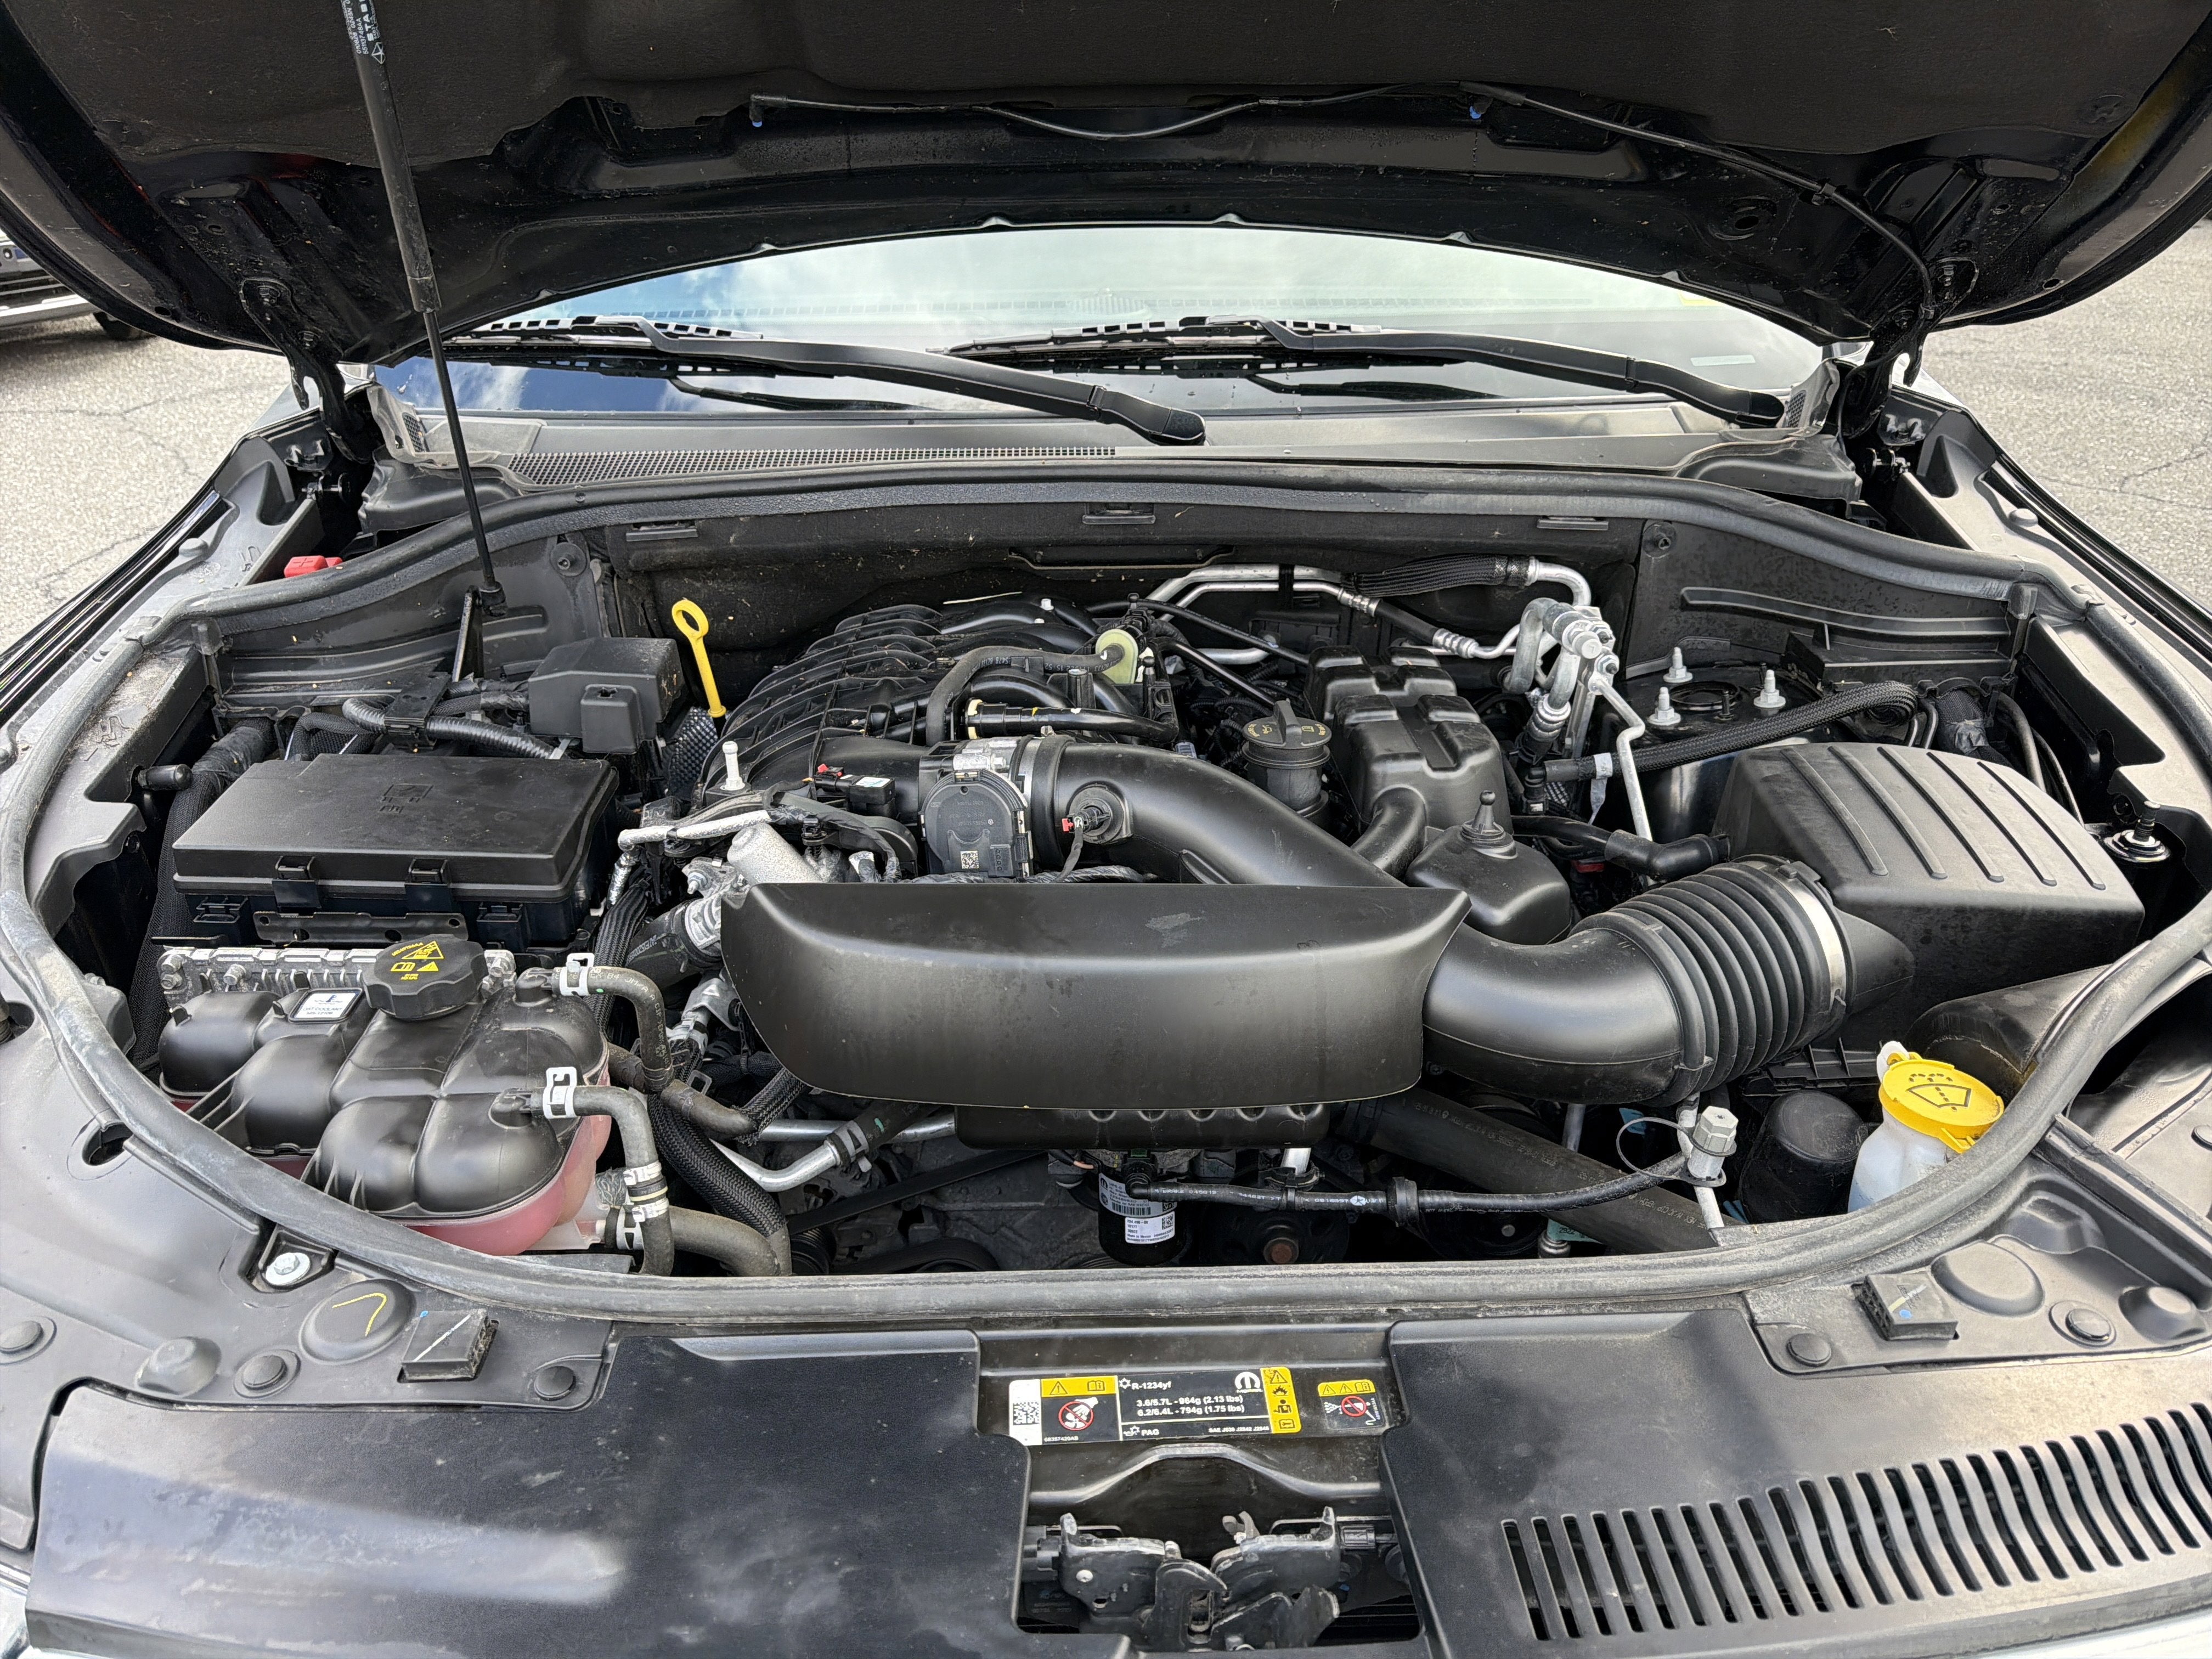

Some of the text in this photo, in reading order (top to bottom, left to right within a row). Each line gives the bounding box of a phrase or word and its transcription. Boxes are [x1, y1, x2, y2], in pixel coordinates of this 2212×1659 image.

[1132, 1381, 1172, 1390] R-1234yf
[1137, 1398, 1172, 1407] 3.6/5.7L
[1179, 1397, 1201, 1406] 964g
[1203, 1395, 1225, 1404] (2.13
[1226, 1395, 1243, 1403] lbs)
[1137, 1407, 1173, 1417] 6.2/6.4L
[1181, 1406, 1203, 1415] 794g
[1205, 1406, 1227, 1414] (1.75
[1227, 1404, 1245, 1413] lbs)
